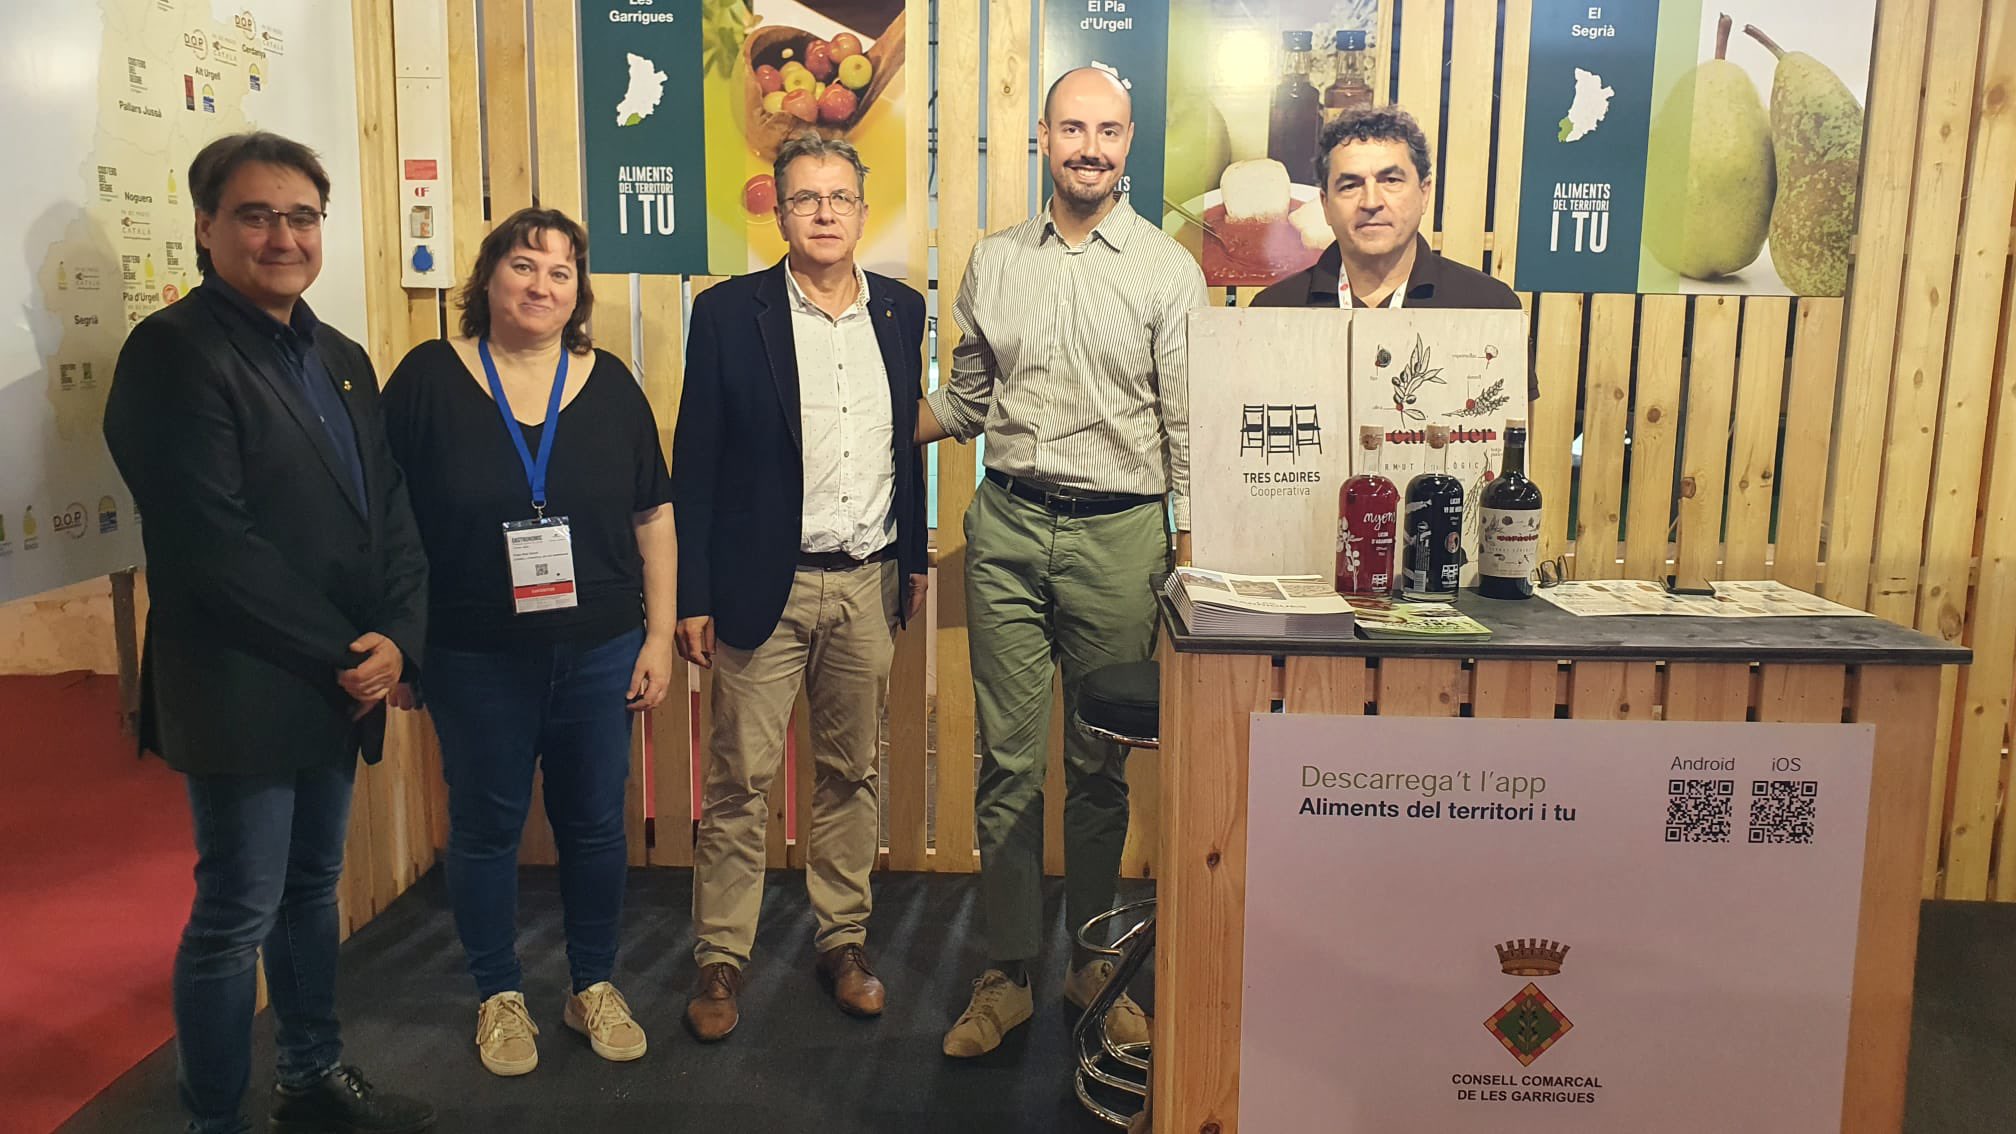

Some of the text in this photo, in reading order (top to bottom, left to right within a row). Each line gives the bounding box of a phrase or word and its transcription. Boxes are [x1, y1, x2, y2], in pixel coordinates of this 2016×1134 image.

[1088, 0, 1126, 13] El Pla
[1588, 7, 1602, 19] El
[609, 9, 674, 25] Garrigues
[1080, 17, 1132, 33] d'Urgell
[1571, 24, 1615, 39] Segrià
[118, 99, 142, 114] Pallars
[619, 166, 674, 182] ALIMENTS
[619, 182, 674, 194] DEL TERRITORI
[1553, 182, 1611, 200] ALIMENTS
[124, 191, 152, 204] Noguera
[1552, 199, 1609, 212] DEL TERRITORI
[619, 193, 675, 236] I TU
[1550, 210, 1609, 253] I TU
[122, 291, 134, 302] Pla
[74, 315, 99, 327] Segrià
[1242, 471, 1321, 484] TRES CADIRES
[1250, 485, 1311, 500] Cooperativa
[1670, 756, 1802, 772] Android iOS
[1299, 797, 1577, 821] Aliments del territori i tu
[1452, 1073, 1603, 1088] CONSELL COMARCAL
[1457, 1089, 1596, 1104] DE LES GARRIGUES
